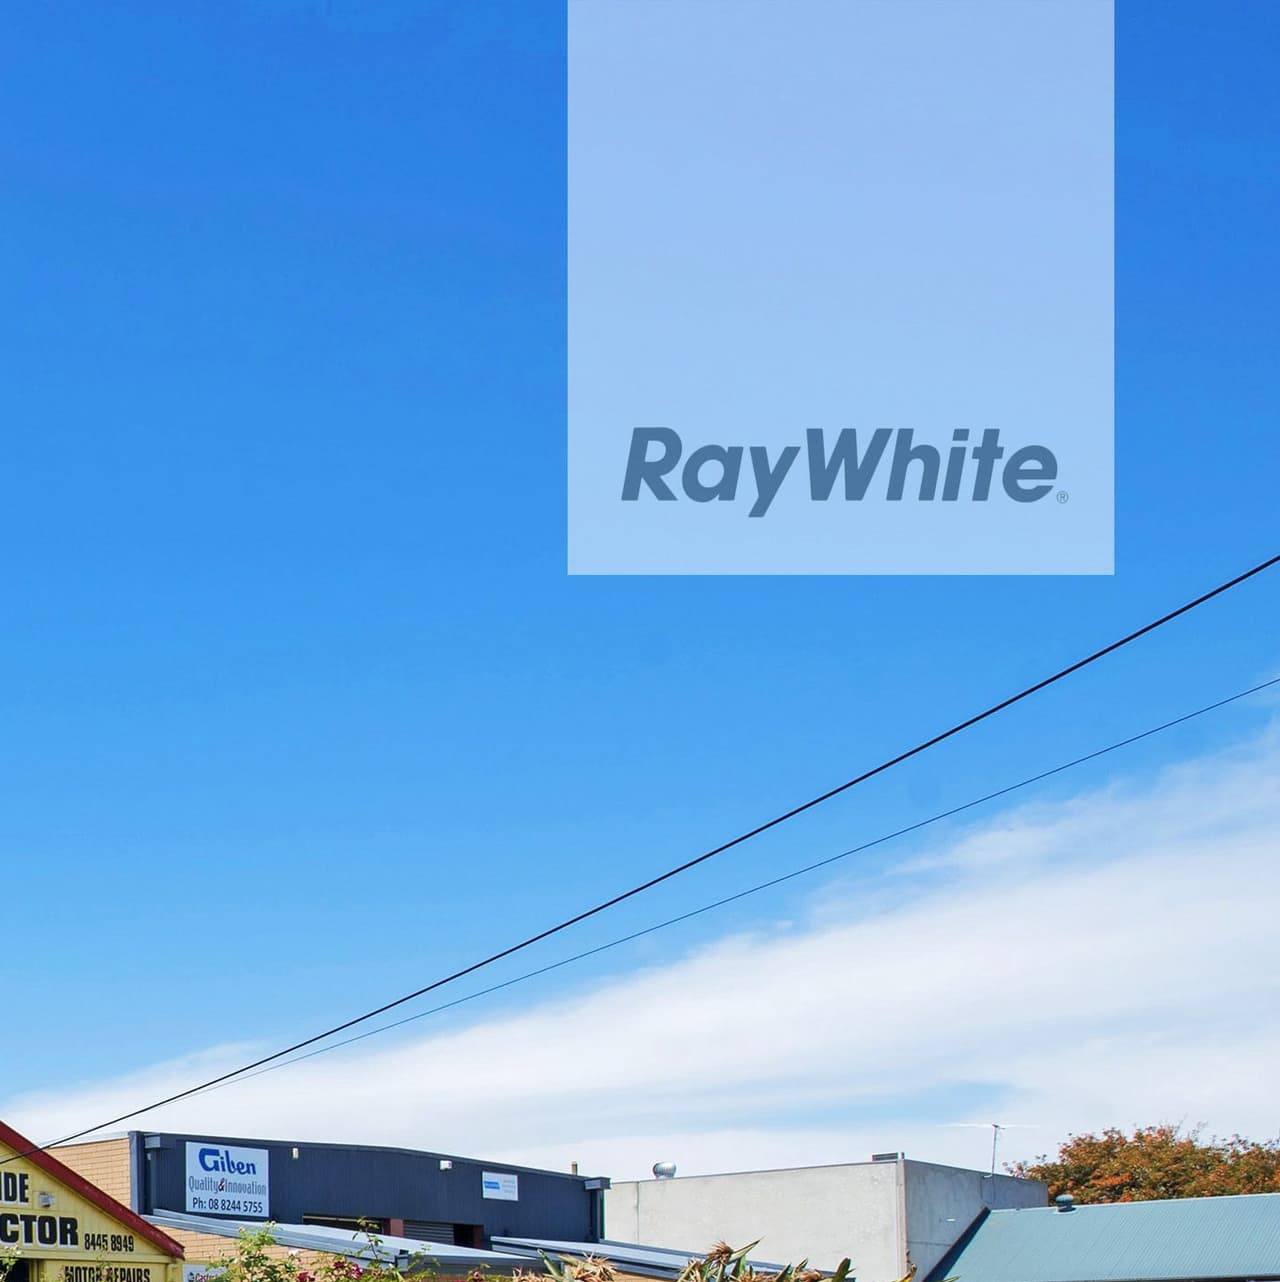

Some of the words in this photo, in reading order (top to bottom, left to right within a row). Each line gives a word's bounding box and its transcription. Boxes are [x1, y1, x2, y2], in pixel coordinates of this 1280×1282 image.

[199, 1148, 256, 1175] Giben
[193, 1197, 206, 1209] Ph:
[208, 1198, 219, 1210] 08
[221, 1199, 241, 1212] 8244
[243, 1201, 263, 1213] 5755
[84, 1233, 108, 1251] 8445
[111, 1235, 134, 1252] 8949
